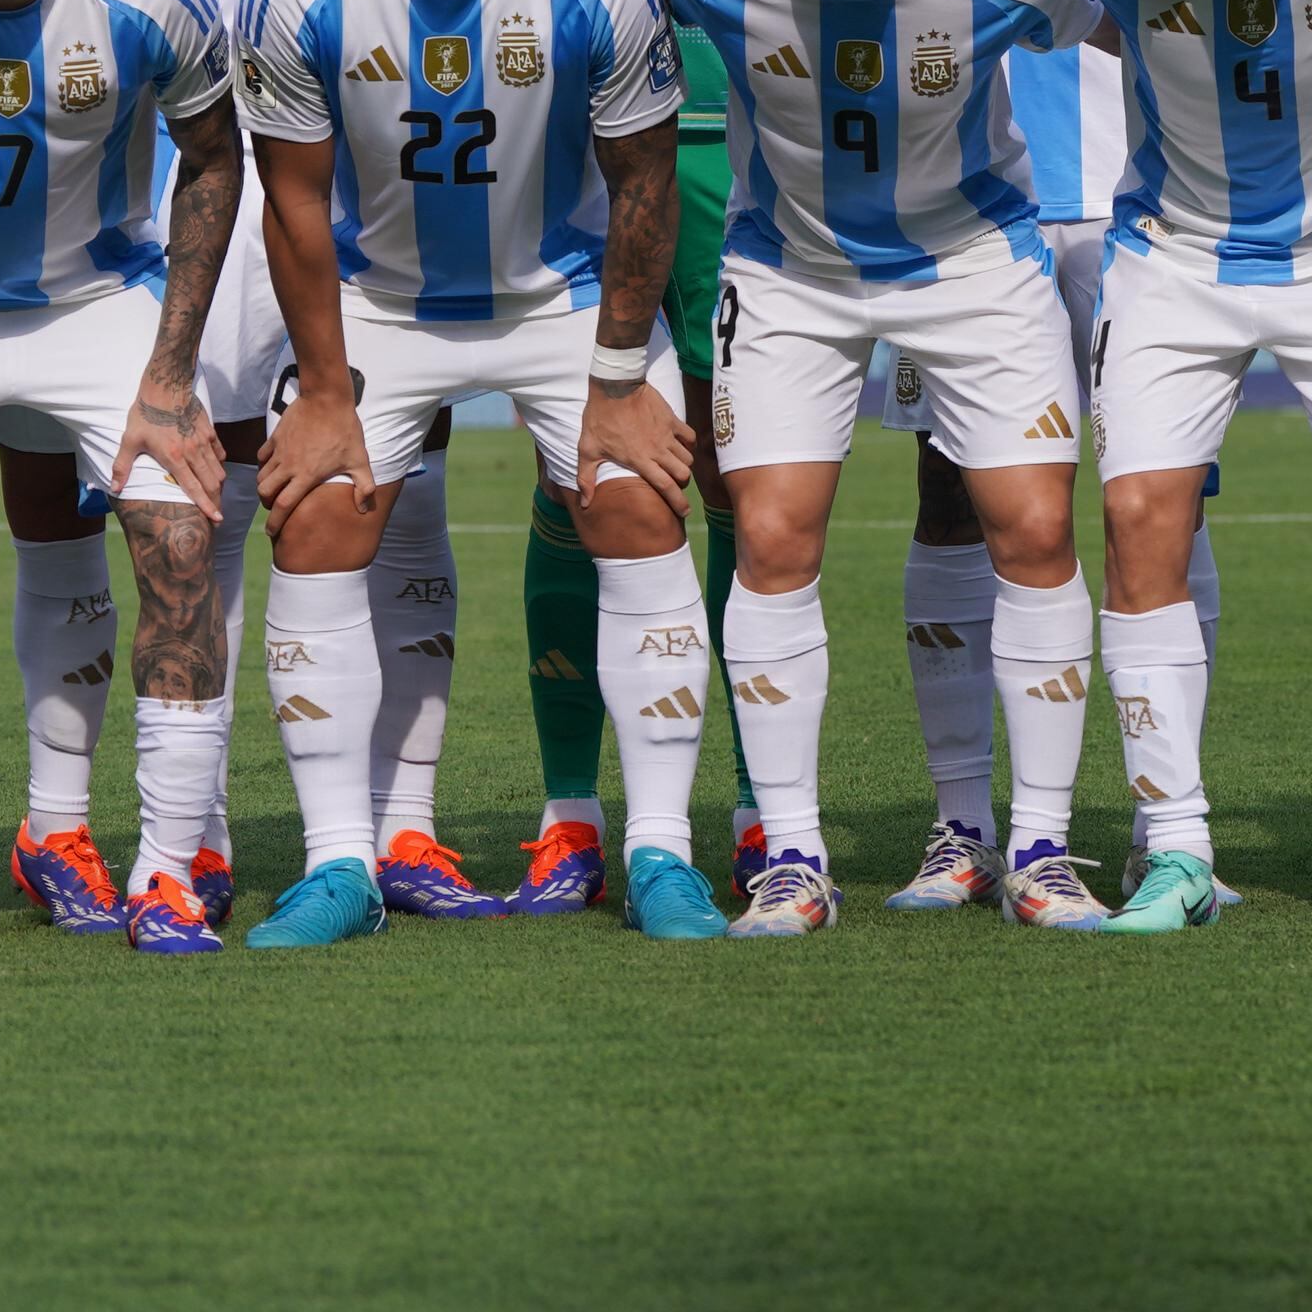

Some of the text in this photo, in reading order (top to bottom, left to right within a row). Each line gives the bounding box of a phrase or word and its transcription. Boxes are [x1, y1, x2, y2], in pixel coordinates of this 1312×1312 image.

[506, 48, 536, 72] AFA
[920, 61, 950, 84] AFA
[69, 75, 98, 102] AFA
[437, 72, 458, 81] FIFA
[1234, 59, 1282, 120] 4
[399, 109, 497, 185] 22
[833, 109, 880, 173] 9
[718, 285, 739, 368] 9
[898, 369, 923, 392] AFA
[395, 575, 455, 604] AFA
[68, 587, 113, 623] AFA
[636, 626, 704, 657] AFA
